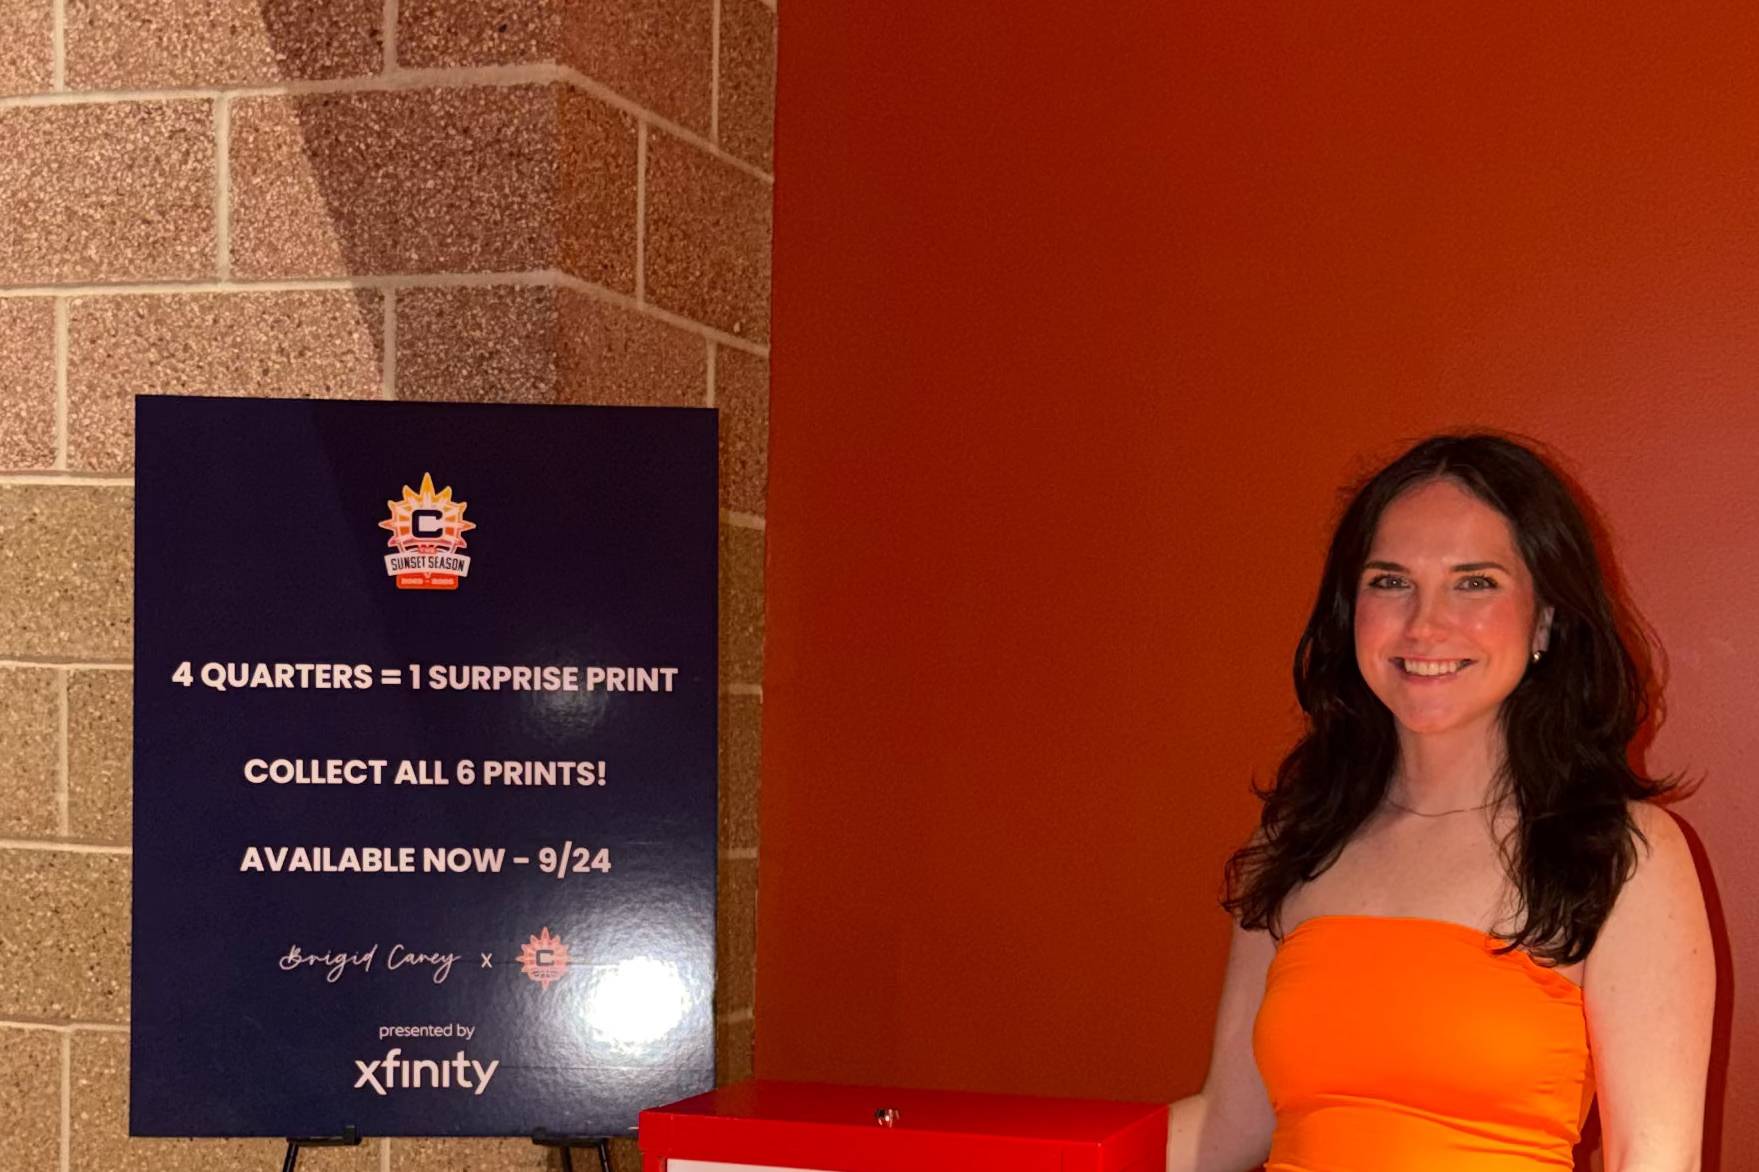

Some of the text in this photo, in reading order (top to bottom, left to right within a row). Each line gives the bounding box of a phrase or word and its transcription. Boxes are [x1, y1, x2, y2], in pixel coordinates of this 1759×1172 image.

[412, 509, 443, 538] C
[391, 556, 465, 572] SUNSET SEASON
[172, 661, 194, 687] 4
[200, 662, 373, 691] QUARTERS
[409, 664, 420, 690] 1
[428, 665, 579, 691] SURPRISE
[586, 667, 679, 692] PRINT
[244, 758, 607, 787] COLLECT ALL 6 PRINTS!
[240, 846, 415, 873] AVAILABLE
[423, 847, 505, 873] NOW
[538, 841, 612, 879] 9/24
[279, 944, 378, 983] Brigid
[387, 944, 462, 984] Carey
[379, 1024, 475, 1040] presented by
[353, 1048, 500, 1096] xfinity
